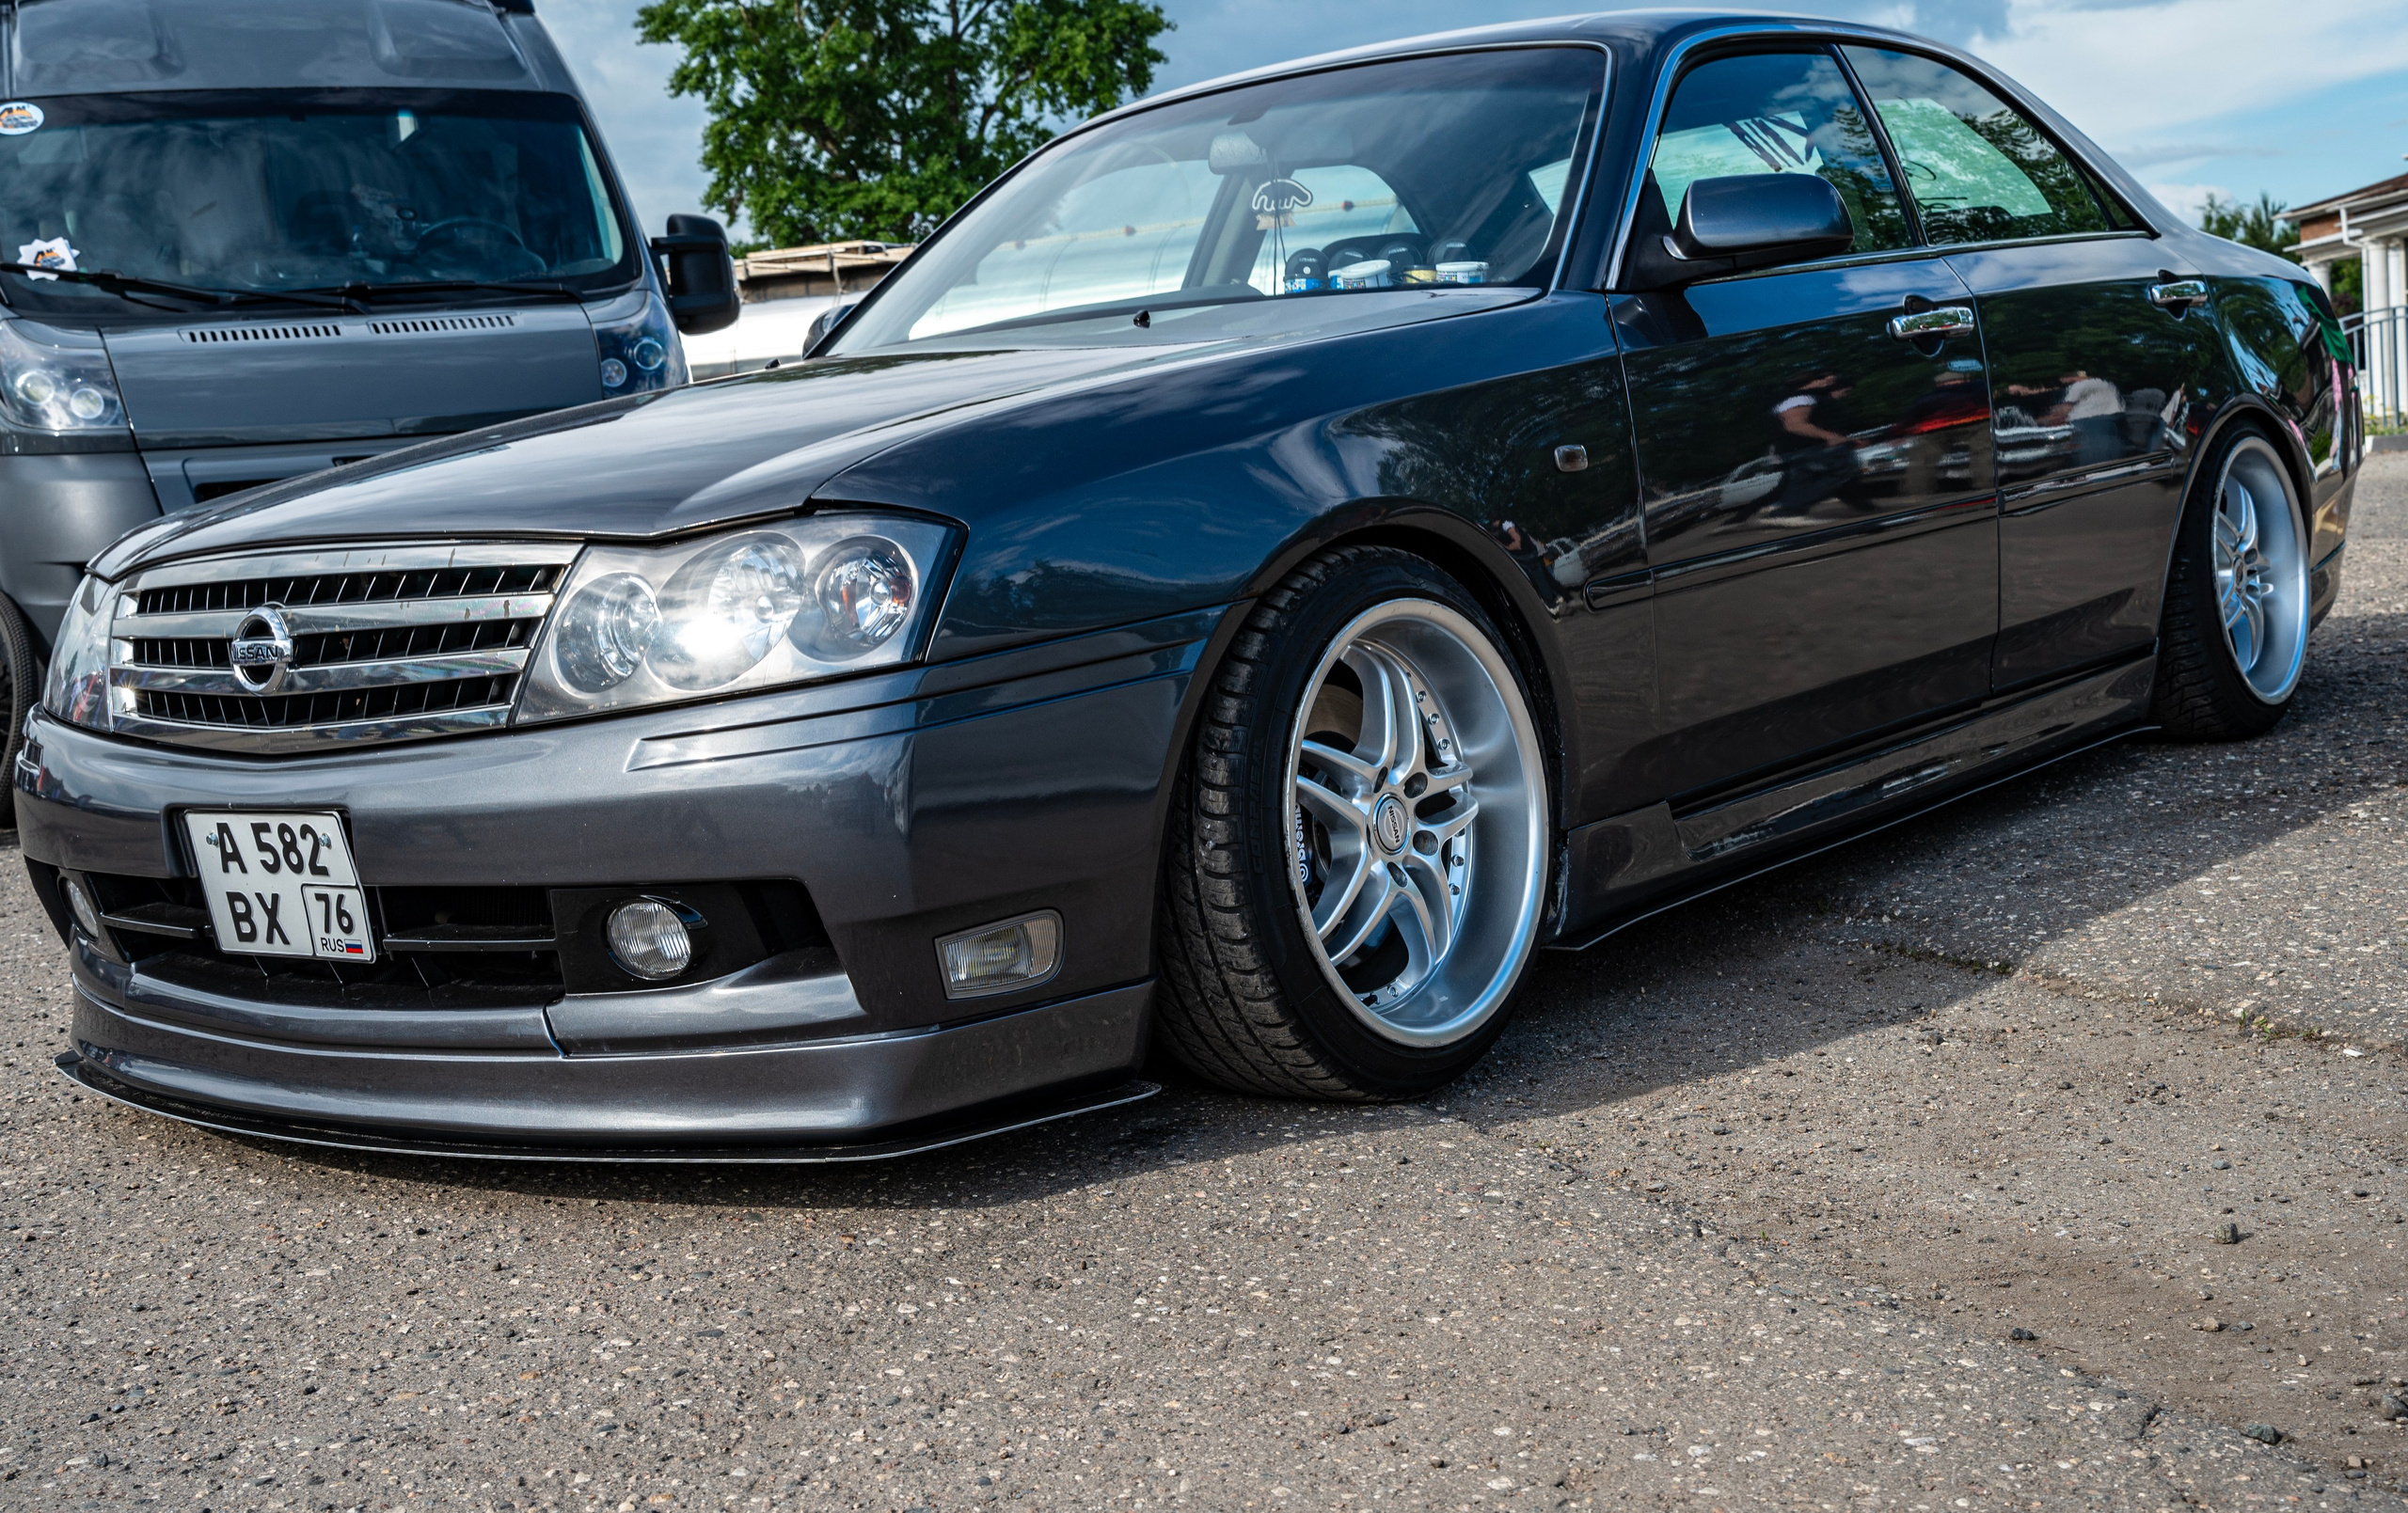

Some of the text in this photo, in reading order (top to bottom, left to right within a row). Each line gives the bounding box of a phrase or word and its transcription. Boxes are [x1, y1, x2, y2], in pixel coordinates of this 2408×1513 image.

[1387, 805, 1401, 843] NISSAN
[250, 822, 330, 876] 582
[314, 893, 354, 935] 76
[321, 938, 345, 953] RUS
